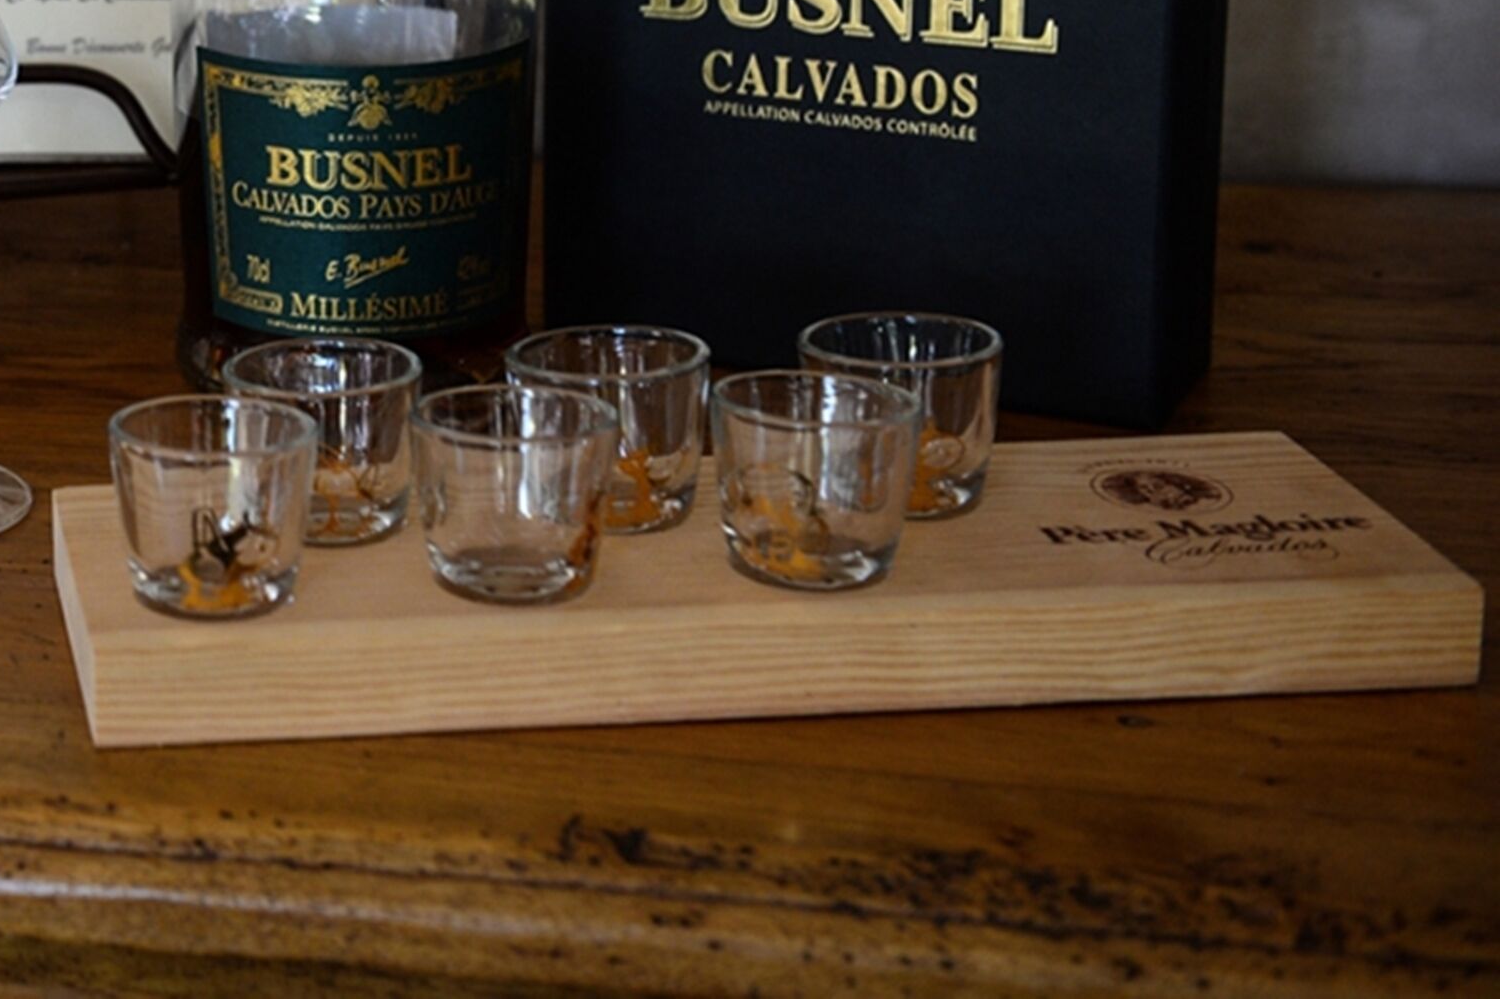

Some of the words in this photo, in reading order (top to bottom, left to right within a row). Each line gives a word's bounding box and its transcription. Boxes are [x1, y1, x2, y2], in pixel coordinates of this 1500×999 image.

[701, 47, 980, 120] CALVADOS
[703, 100, 801, 123] APPELLATION
[803, 109, 883, 132] CALVADOS
[886, 117, 978, 142] CONTRÔLÉE
[264, 144, 473, 192] BUSNEL
[230, 180, 351, 221] CALVADOS
[358, 192, 423, 220] PAYS
[289, 286, 449, 322] MILLÉSIMÉ
[1038, 524, 1150, 546] Père
[1152, 510, 1374, 541] Magloire
